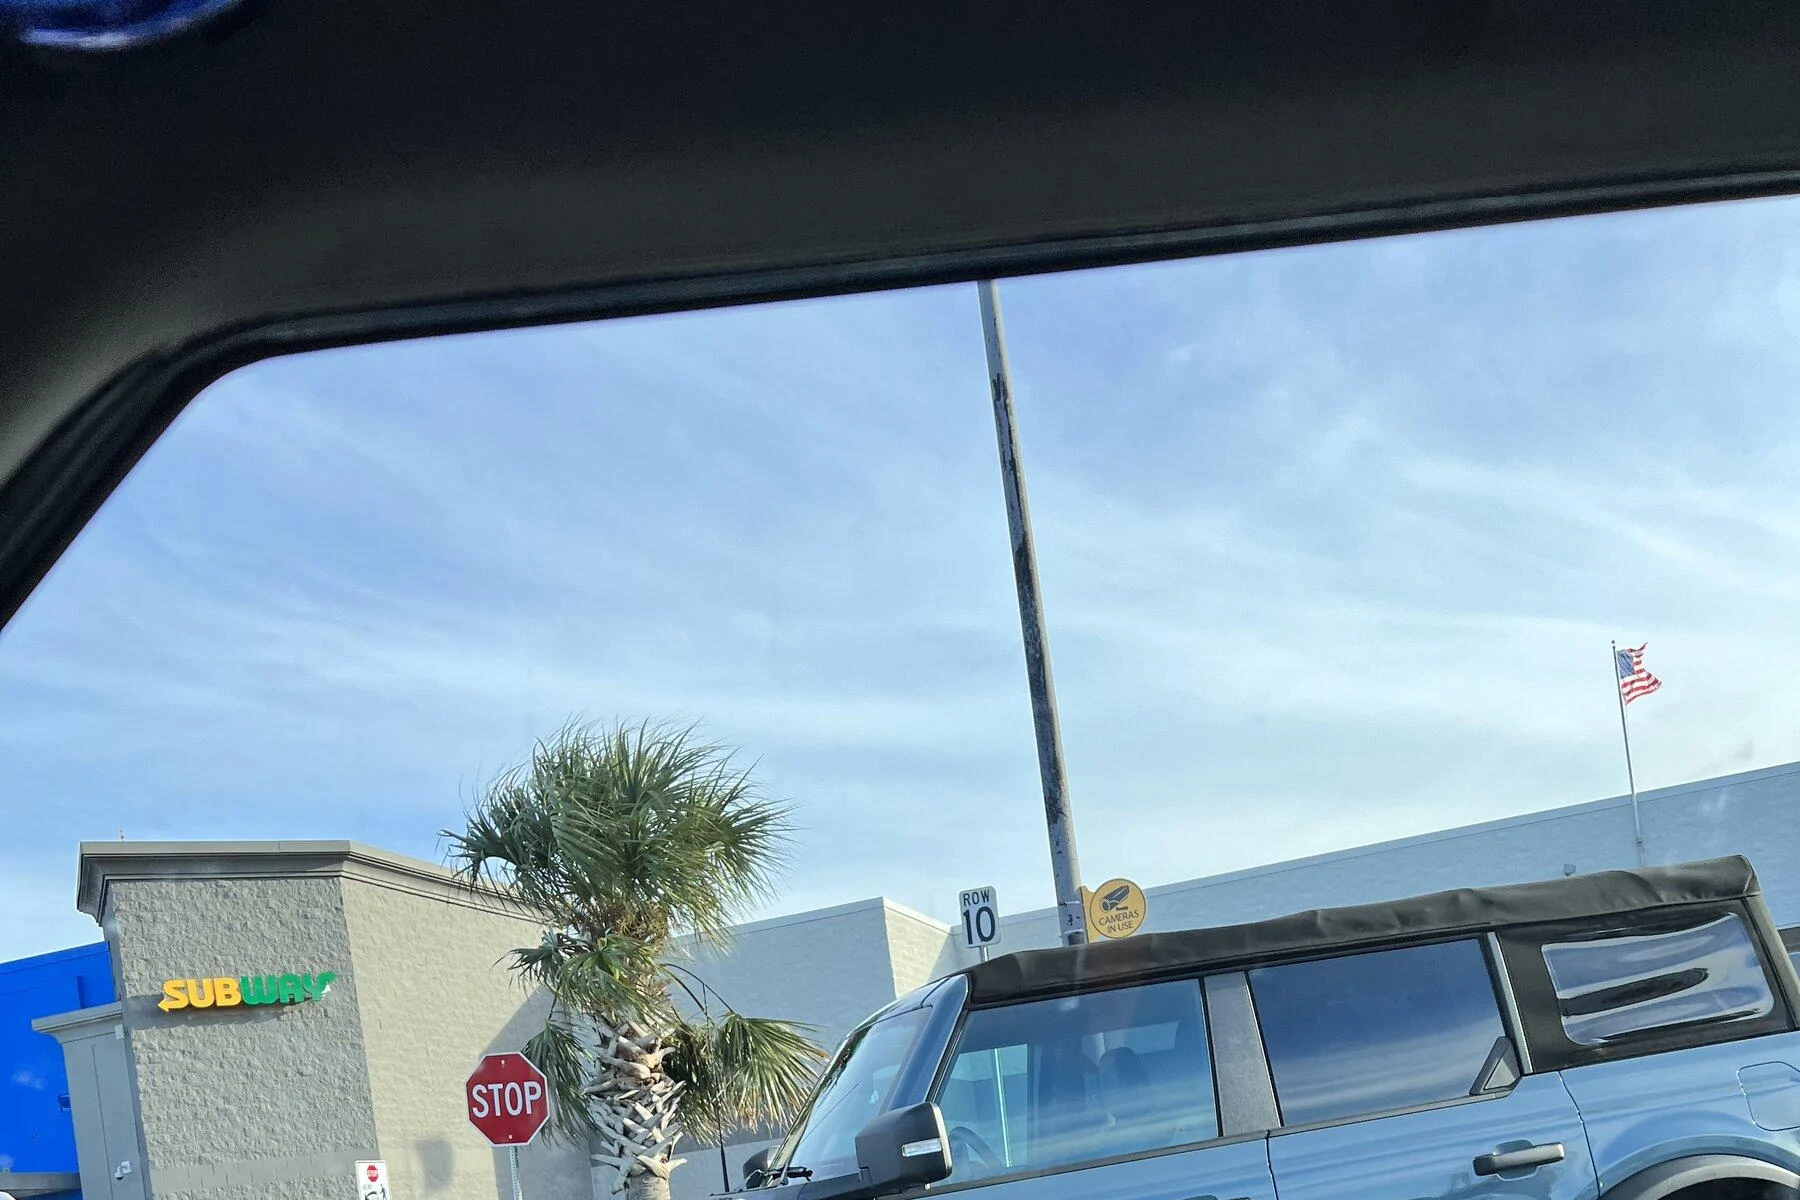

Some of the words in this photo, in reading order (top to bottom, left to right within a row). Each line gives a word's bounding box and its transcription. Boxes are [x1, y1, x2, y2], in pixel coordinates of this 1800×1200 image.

[963, 890, 990, 906] ROW
[963, 906, 996, 944] 10
[1098, 911, 1139, 926] CAMERAS
[1107, 925, 1117, 933] IN
[1117, 921, 1134, 932] USE
[157, 971, 337, 1013] SUBWAY
[472, 1081, 542, 1118] STOP
